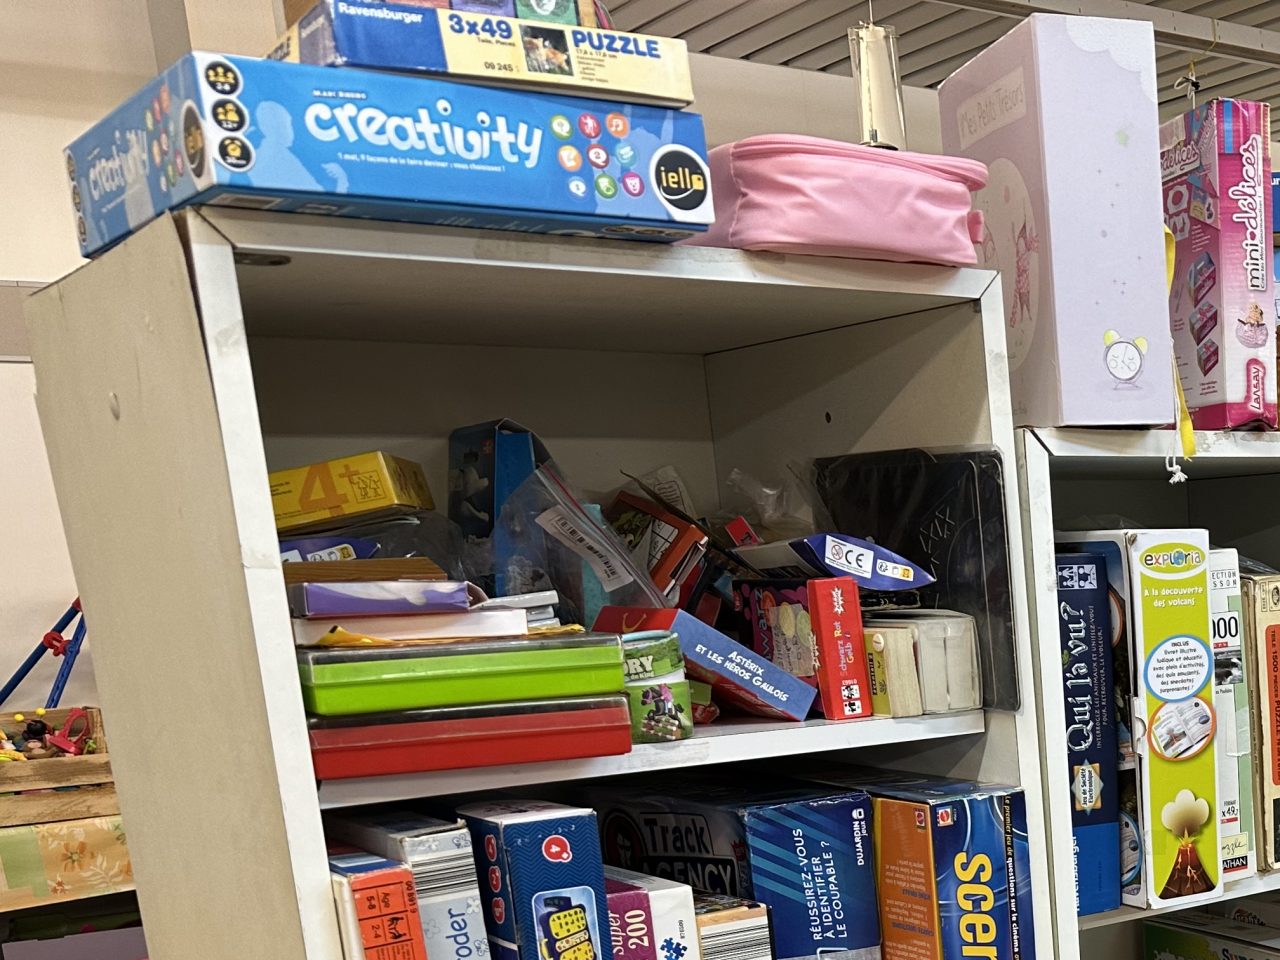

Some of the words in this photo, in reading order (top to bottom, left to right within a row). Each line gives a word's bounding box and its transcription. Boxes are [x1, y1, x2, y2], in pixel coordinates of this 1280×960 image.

[339, 2, 423, 24] Ravensburger
[448, 14, 513, 39] 3x49
[573, 29, 662, 59] PUZZLE
[305, 98, 543, 168] creativity
[1212, 571, 1237, 579] ECTION
[1213, 579, 1237, 588] SSON
[707, 650, 724, 664] LES
[1066, 695, 1094, 751] Qui
[820, 840, 831, 848] ?
[852, 821, 865, 866] DUJARDIN
[1223, 857, 1246, 868] ATHAN
[811, 857, 833, 926] IDENTIFIER
[822, 851, 844, 920] COUPABLE
[625, 910, 649, 949] 200
[823, 929, 836, 939] À
[836, 923, 847, 938] LE
